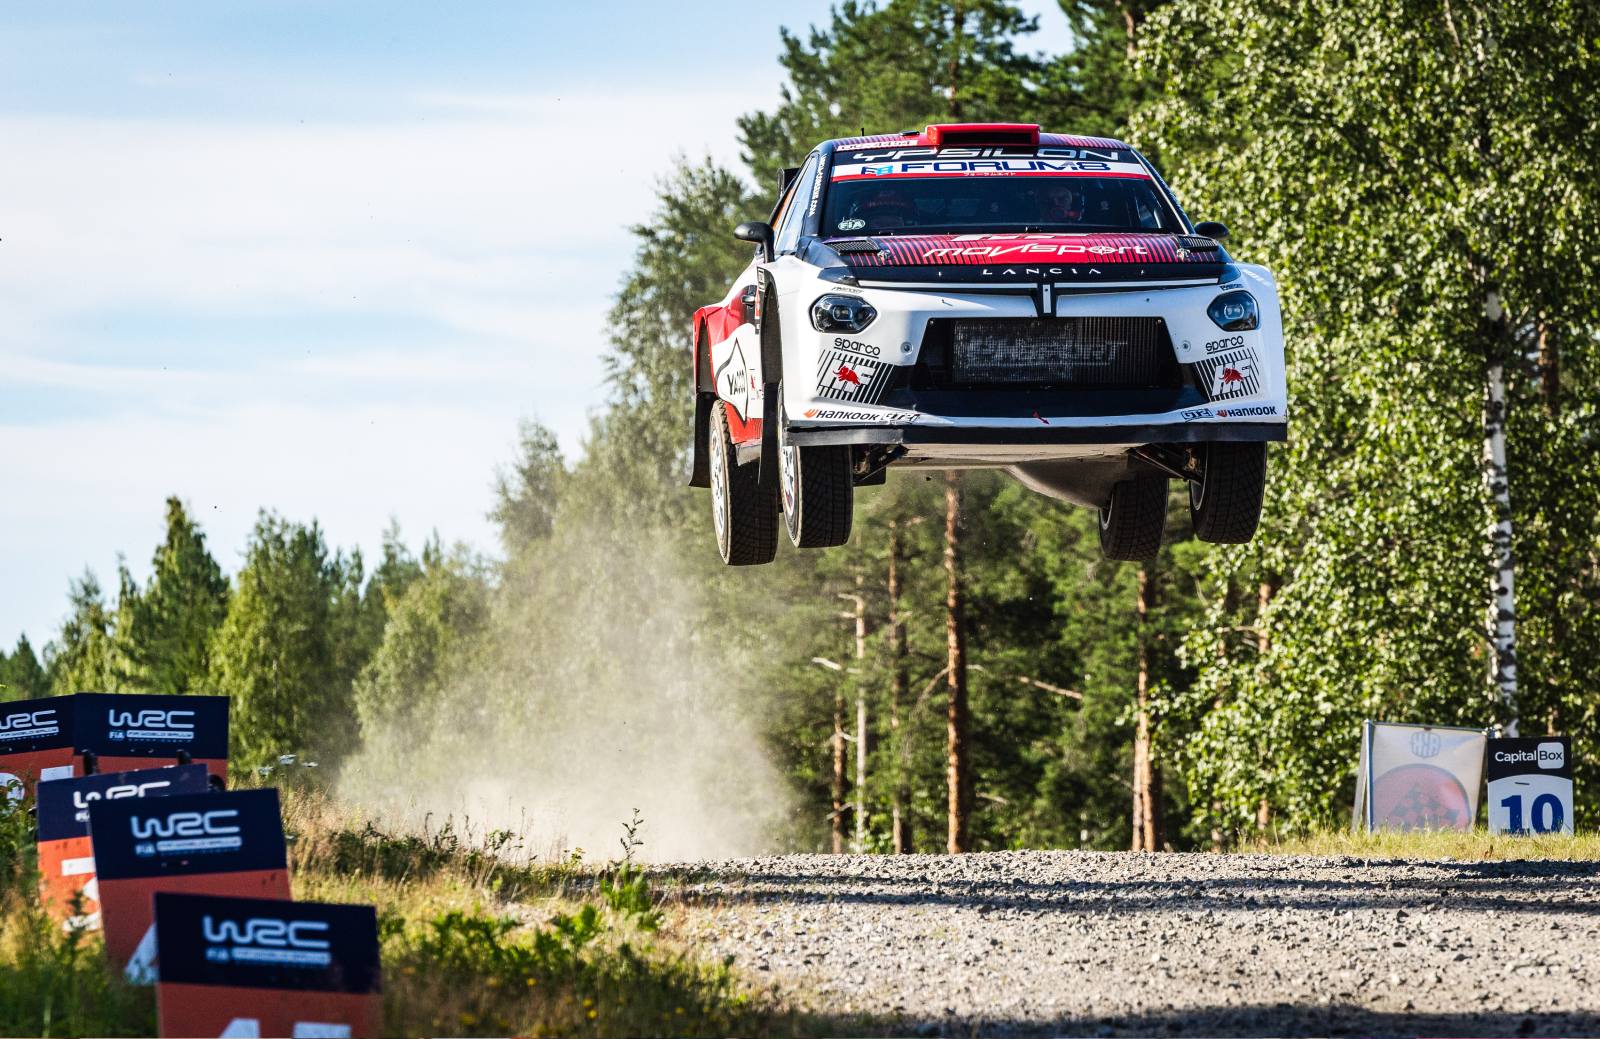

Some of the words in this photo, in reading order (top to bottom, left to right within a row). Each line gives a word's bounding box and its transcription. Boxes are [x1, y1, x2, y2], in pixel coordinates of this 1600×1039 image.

[852, 147, 1119, 161] YPSILON
[901, 160, 1111, 172] FORUM8
[838, 219, 865, 230] FIA
[834, 337, 881, 357] sparco
[1206, 335, 1244, 354] sparco
[108, 708, 195, 729] WRC
[130, 809, 240, 839] WRC
[1500, 793, 1565, 836] 10
[203, 916, 330, 949] WRC
